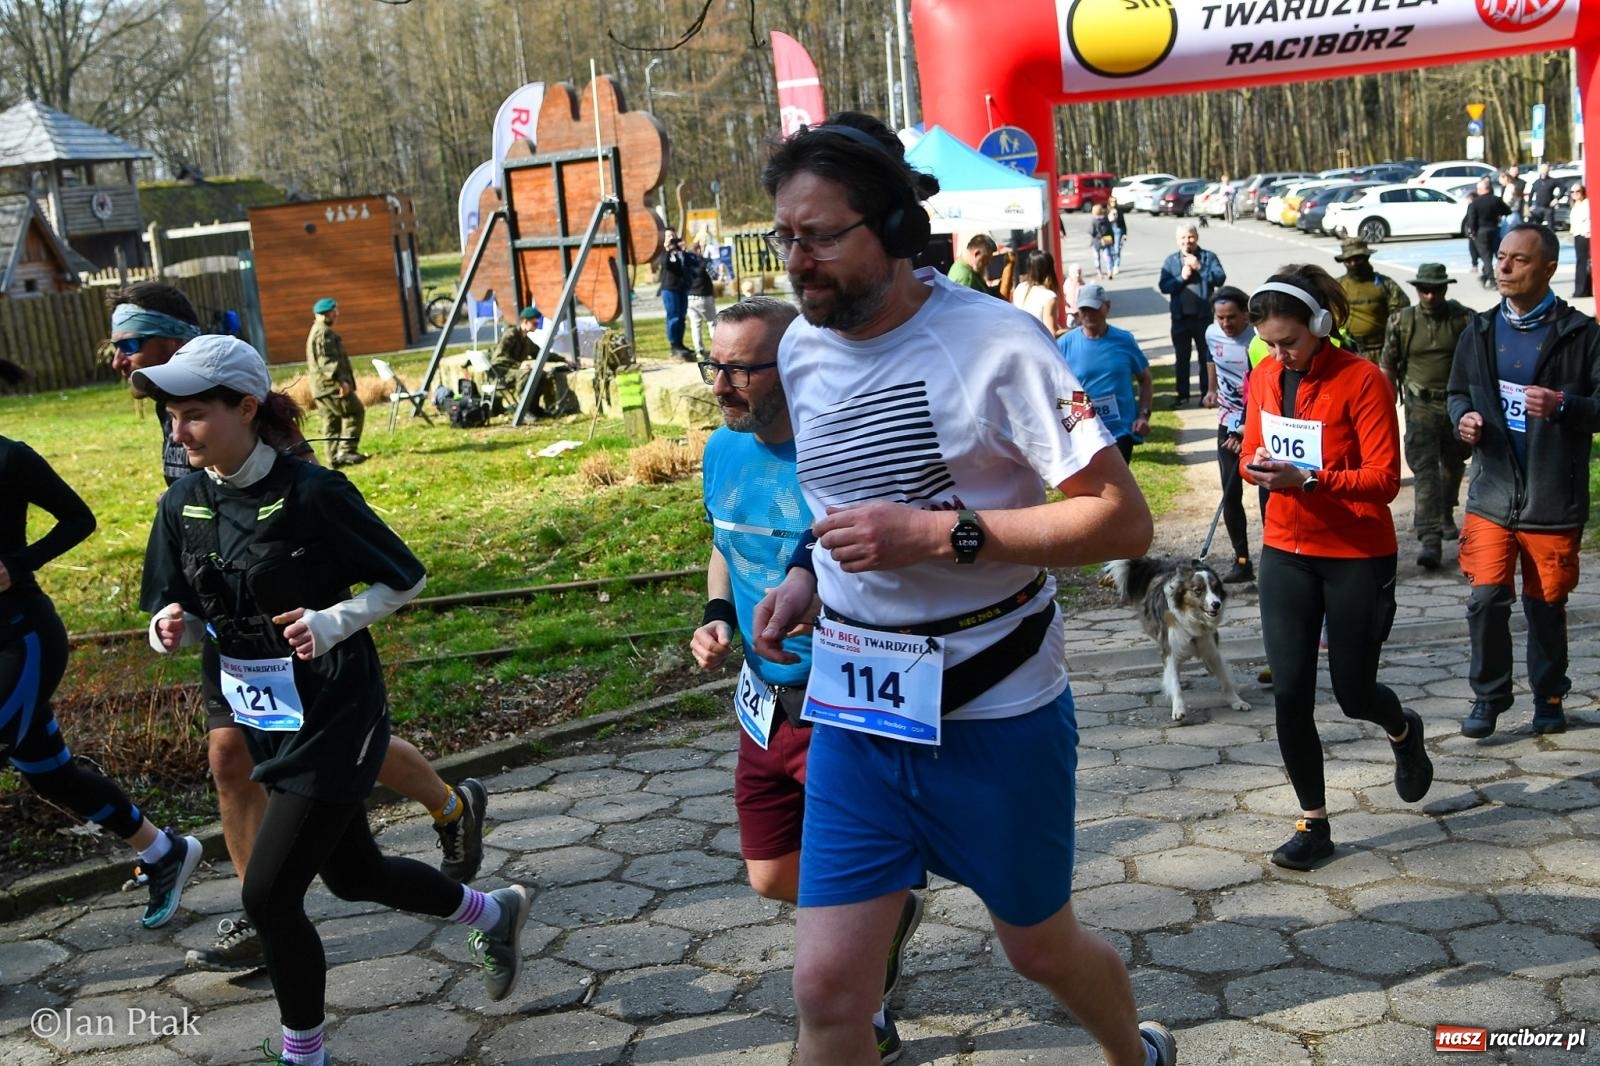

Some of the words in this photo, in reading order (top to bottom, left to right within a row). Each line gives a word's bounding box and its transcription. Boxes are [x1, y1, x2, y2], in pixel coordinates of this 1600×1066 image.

[1202, 0, 1438, 30] TWARDZI
[1226, 24, 1415, 66] RACIBÓRZ
[1061, 411, 1083, 430] BIEG
[1271, 434, 1305, 459] 016
[838, 631, 860, 645] BIEG
[841, 661, 905, 708] 114
[236, 685, 277, 711] 121
